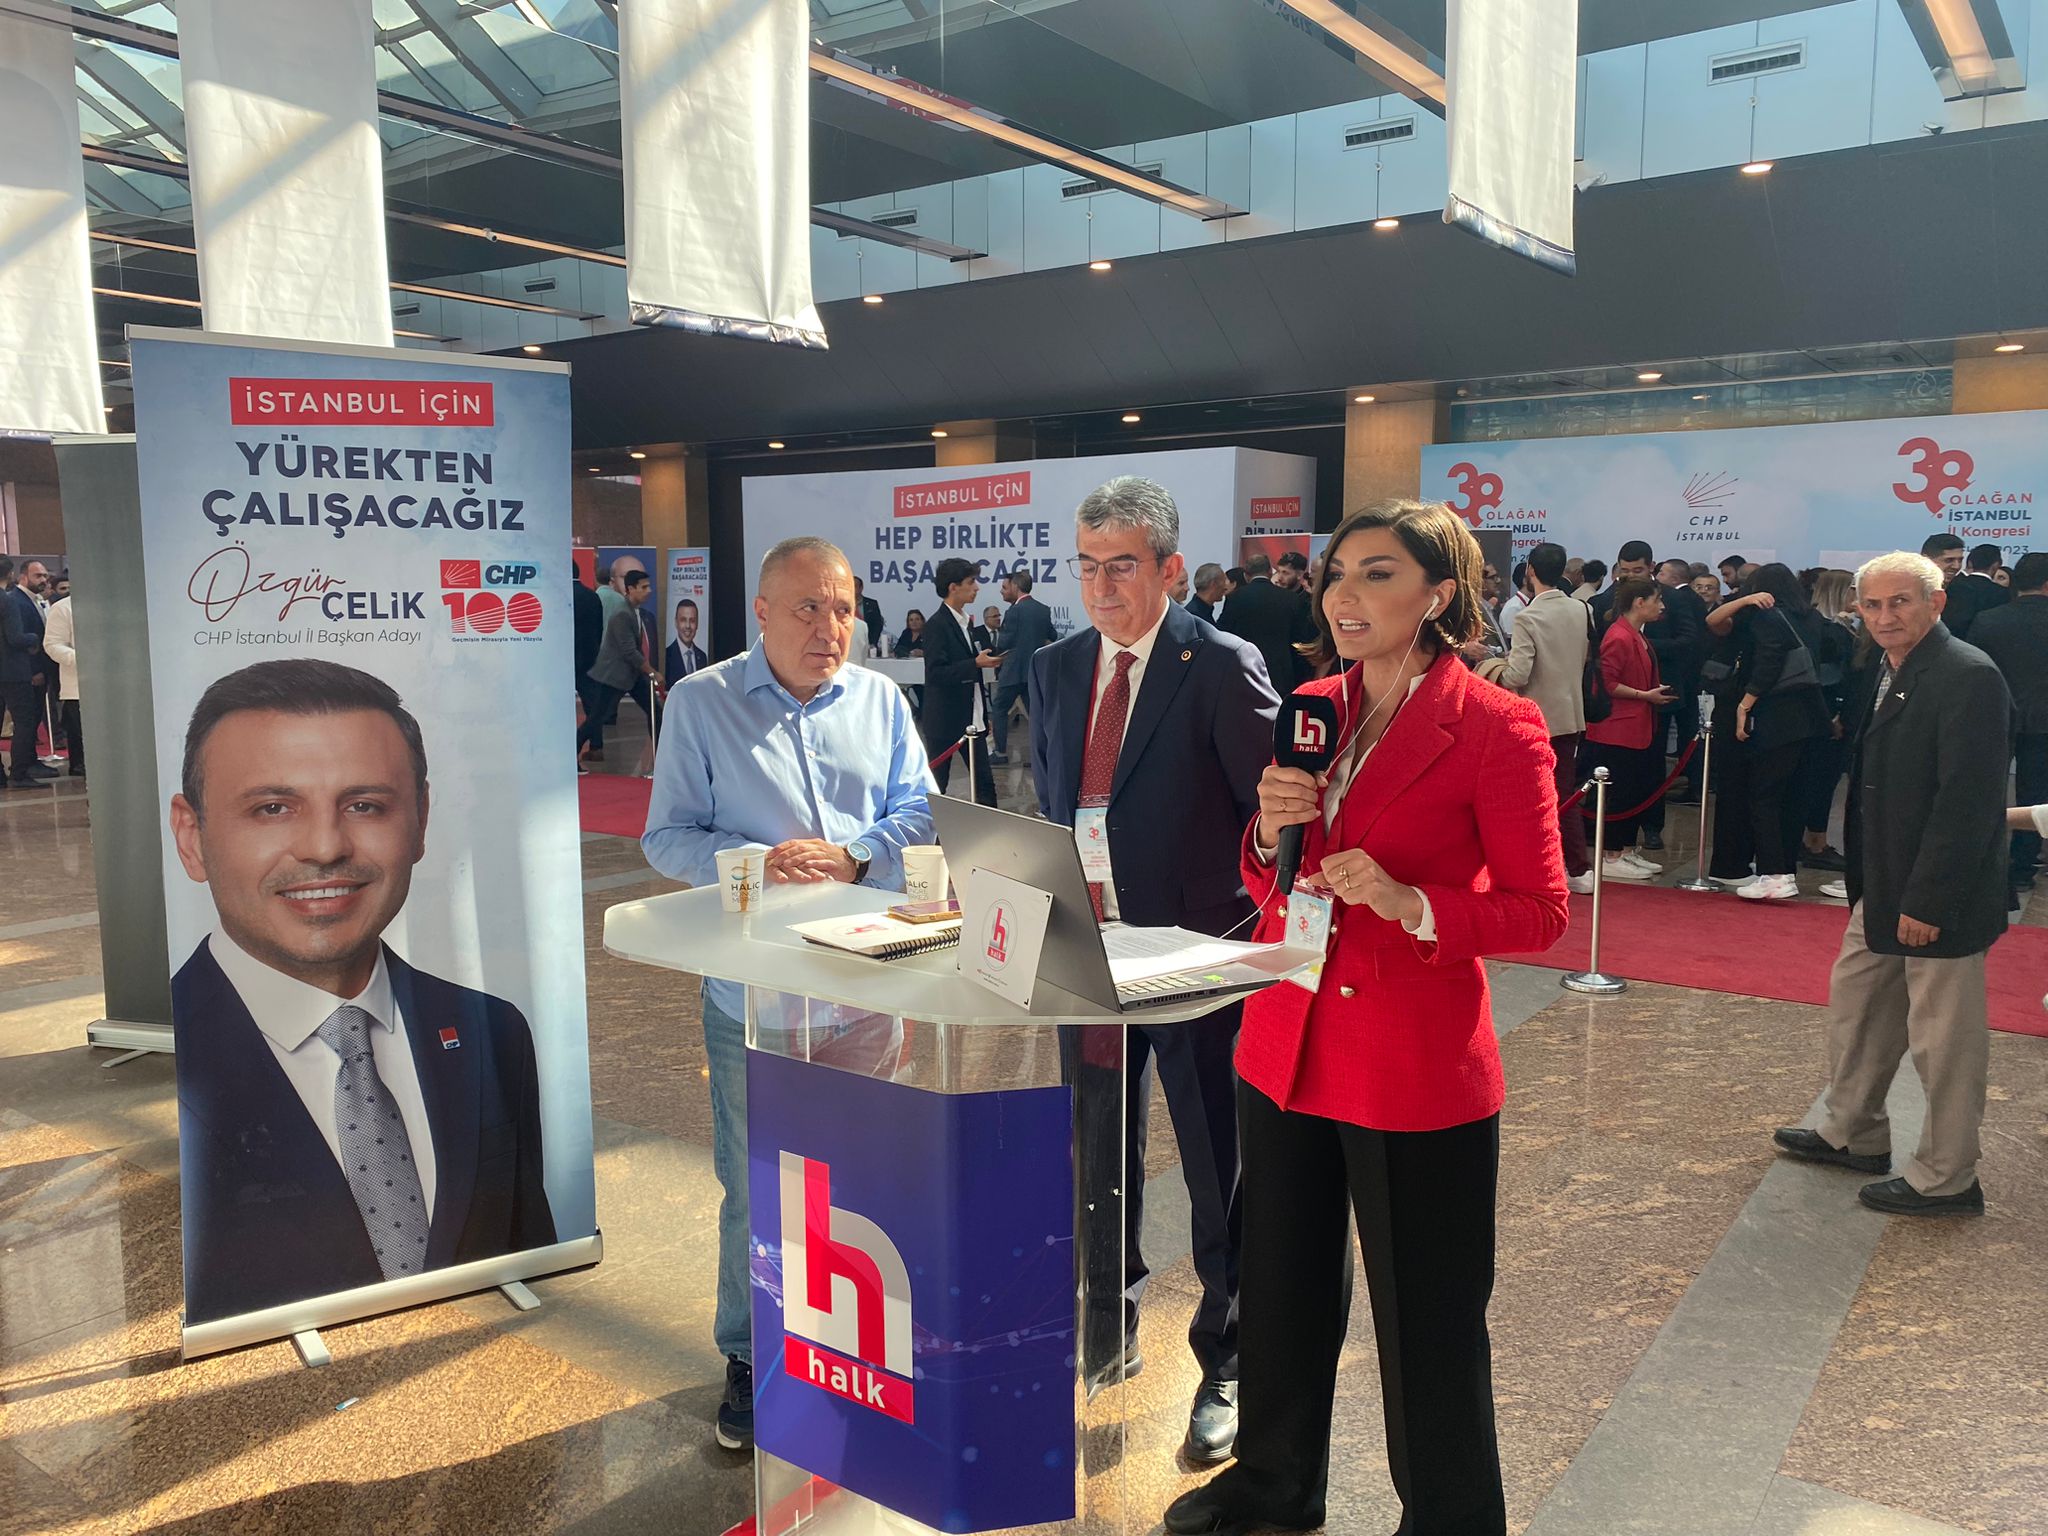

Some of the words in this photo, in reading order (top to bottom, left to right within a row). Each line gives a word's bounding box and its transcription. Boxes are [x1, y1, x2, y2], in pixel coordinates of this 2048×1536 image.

[245, 385, 404, 414] İSTANBUL
[419, 387, 481, 422] İÇİN
[236, 434, 493, 485] YÜREKTEN
[900, 487, 980, 509] İSTANBUL
[987, 480, 1023, 504] İÇİN
[1949, 490, 2033, 506] OLAĞAN
[202, 487, 525, 539] ÇALIŞACAĞIZ
[1486, 508, 1547, 520] OLAĞAN
[1689, 515, 1729, 526] CHP
[1947, 509, 2033, 522] İSTANBUL
[875, 526, 922, 550] HEP
[932, 516, 1051, 549] BİRLİKTE
[1676, 531, 1741, 542] İSTANBUL
[1961, 525, 2031, 539] Kongresi
[187, 540, 347, 623] Özgür
[484, 564, 537, 585] CHP
[869, 551, 1057, 592] BAŞACAĞIZ
[441, 592, 543, 634] 100
[193, 630, 232, 646] CHP
[235, 628, 302, 645] İstanbul
[305, 628, 314, 644] İl
[317, 629, 374, 647] Başkan
[377, 628, 422, 646] Adayı
[1299, 744, 1319, 753] halk
[807, 1348, 886, 1409] halk
